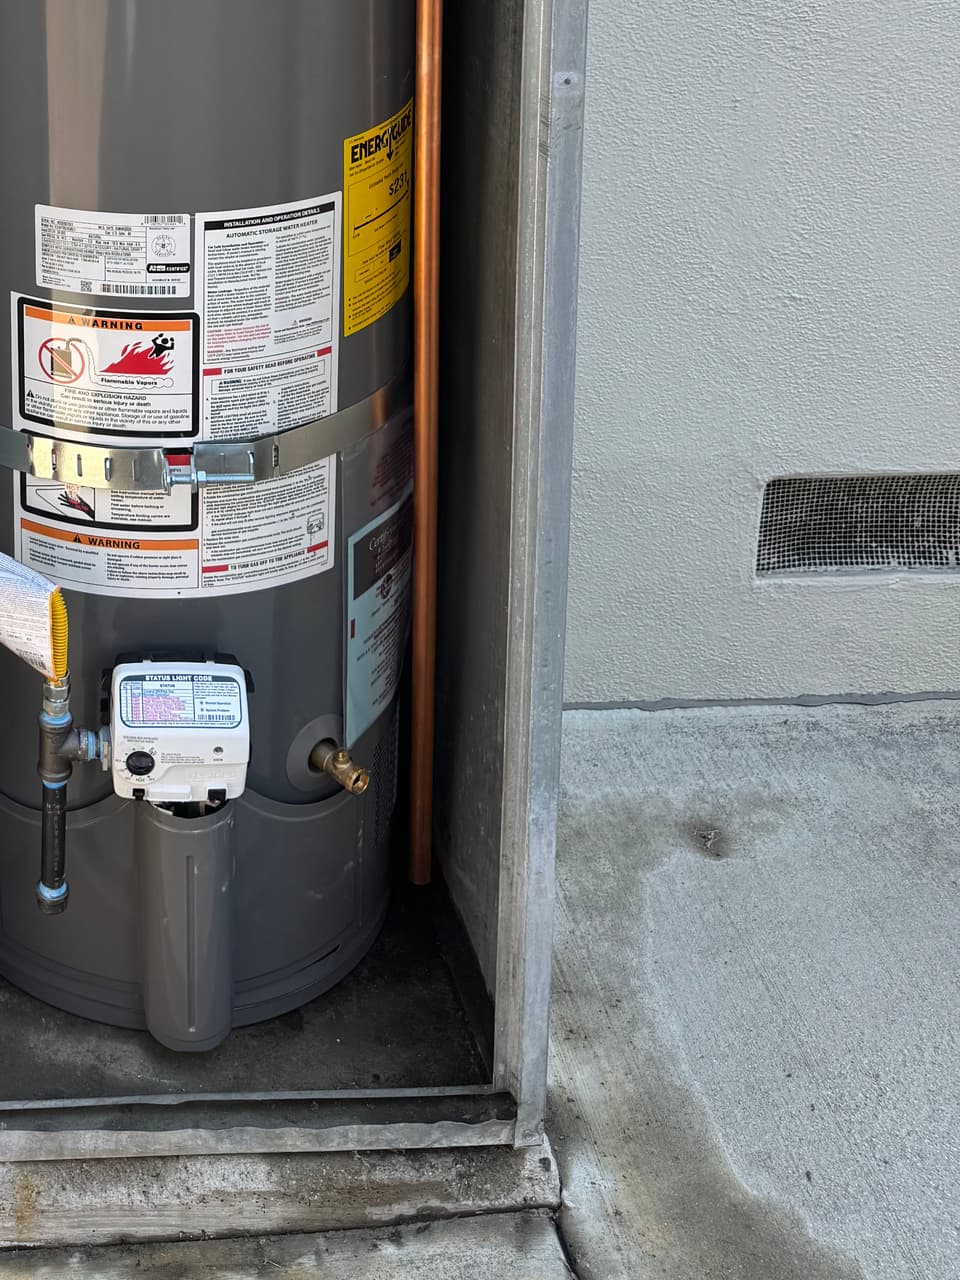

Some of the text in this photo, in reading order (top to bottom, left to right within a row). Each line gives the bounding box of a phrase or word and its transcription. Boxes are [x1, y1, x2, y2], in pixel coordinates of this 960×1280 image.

[81, 317, 143, 330] WARNING
[101, 377, 135, 385] Flammable
[88, 537, 140, 549] WARNING
